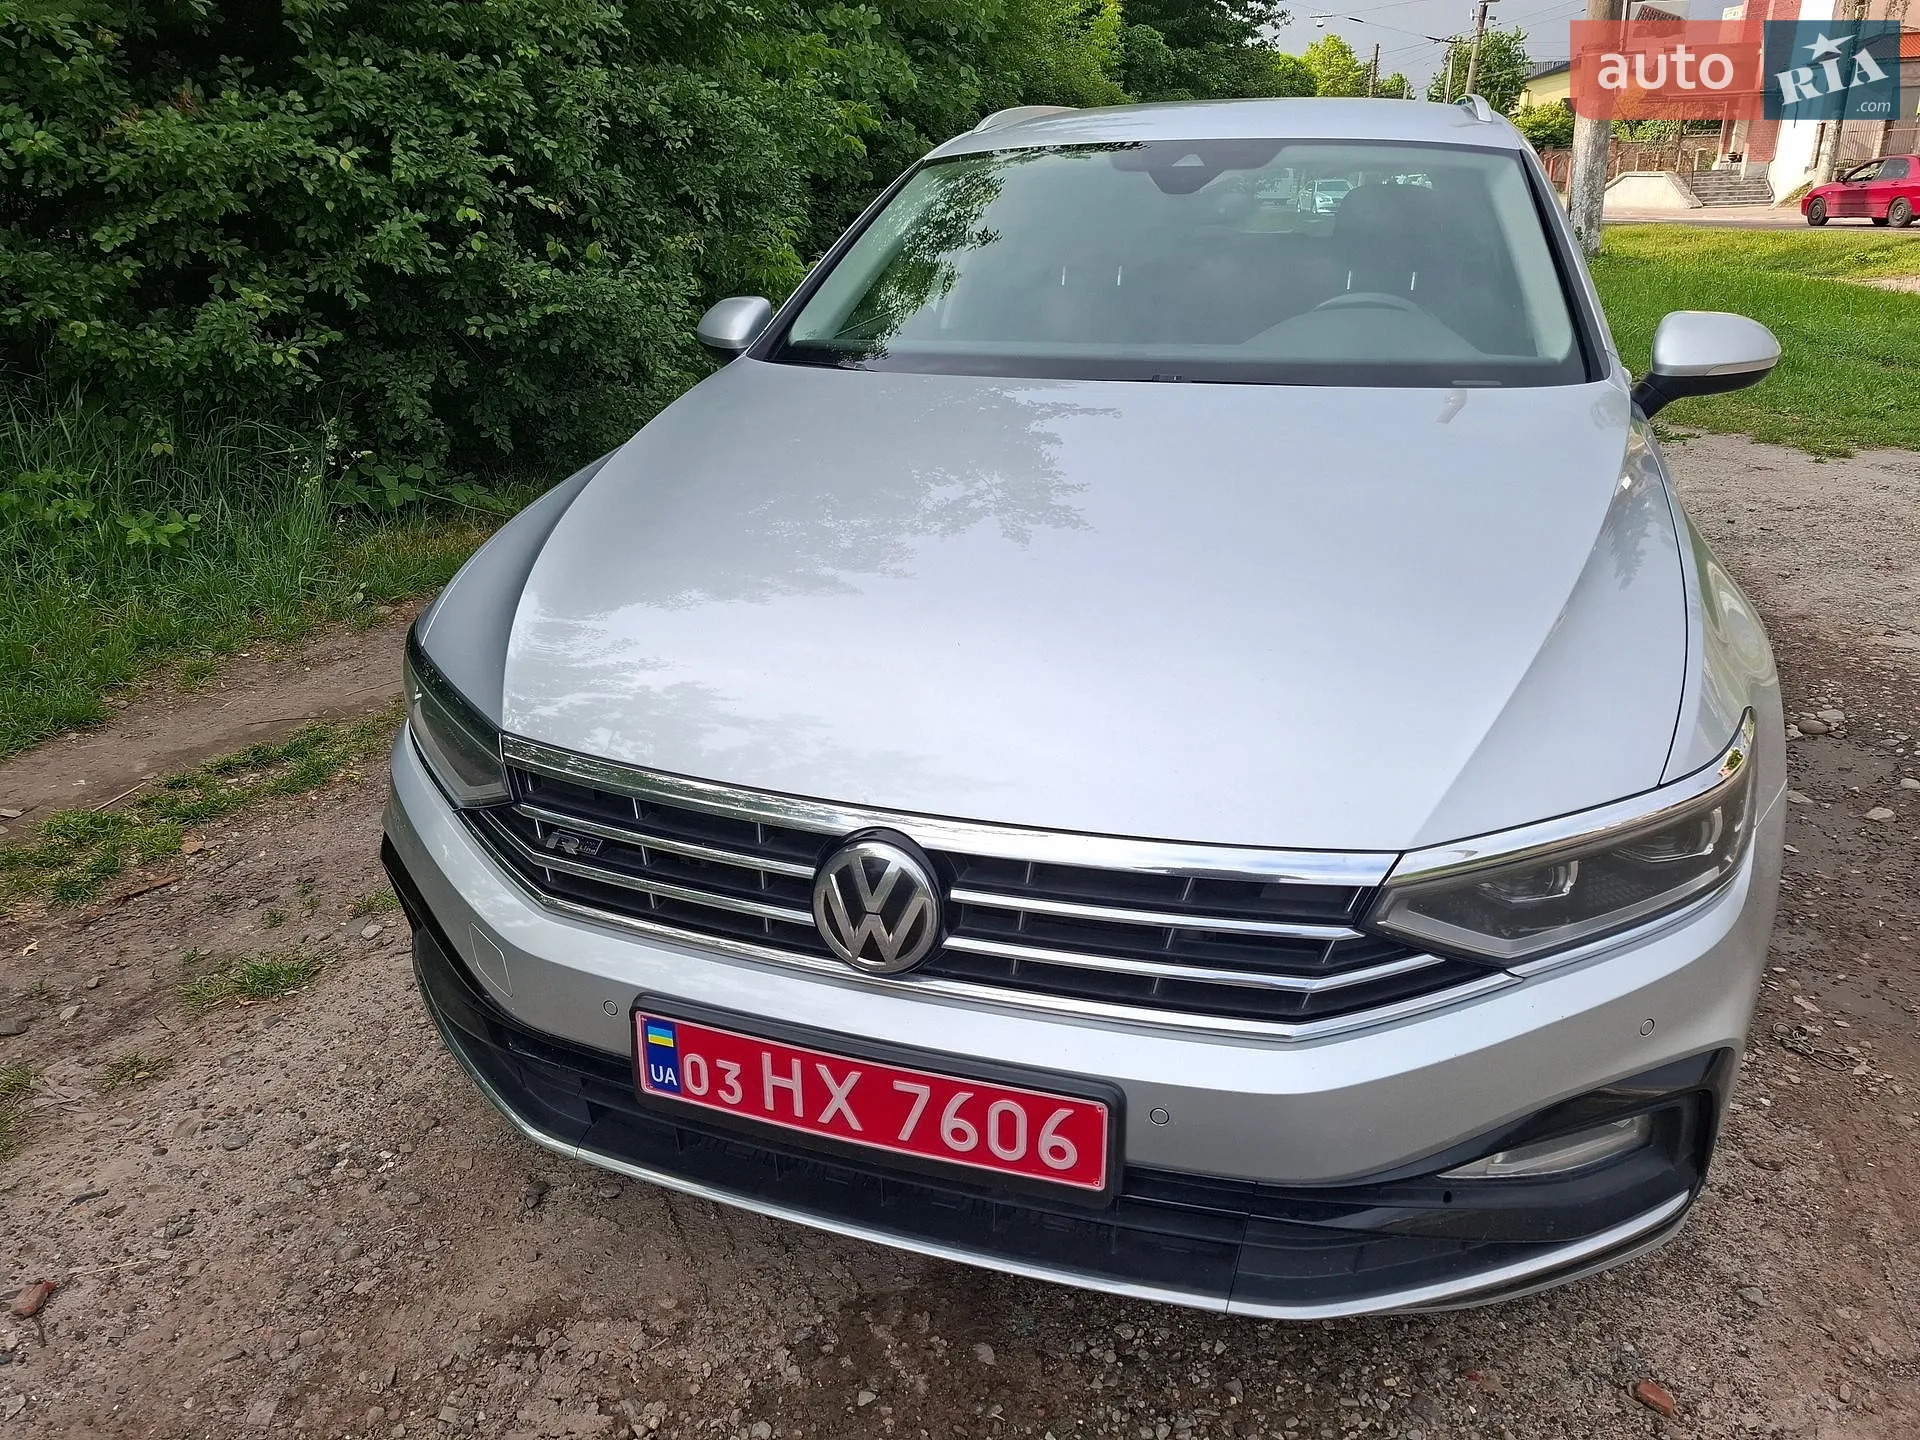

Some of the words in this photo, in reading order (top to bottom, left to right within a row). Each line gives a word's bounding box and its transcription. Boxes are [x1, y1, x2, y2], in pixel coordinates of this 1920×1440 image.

[650, 1063, 677, 1087] UA
[683, 1053, 743, 1105] 03
[761, 1052, 863, 1132] HX
[893, 1080, 1078, 1171] 7606
